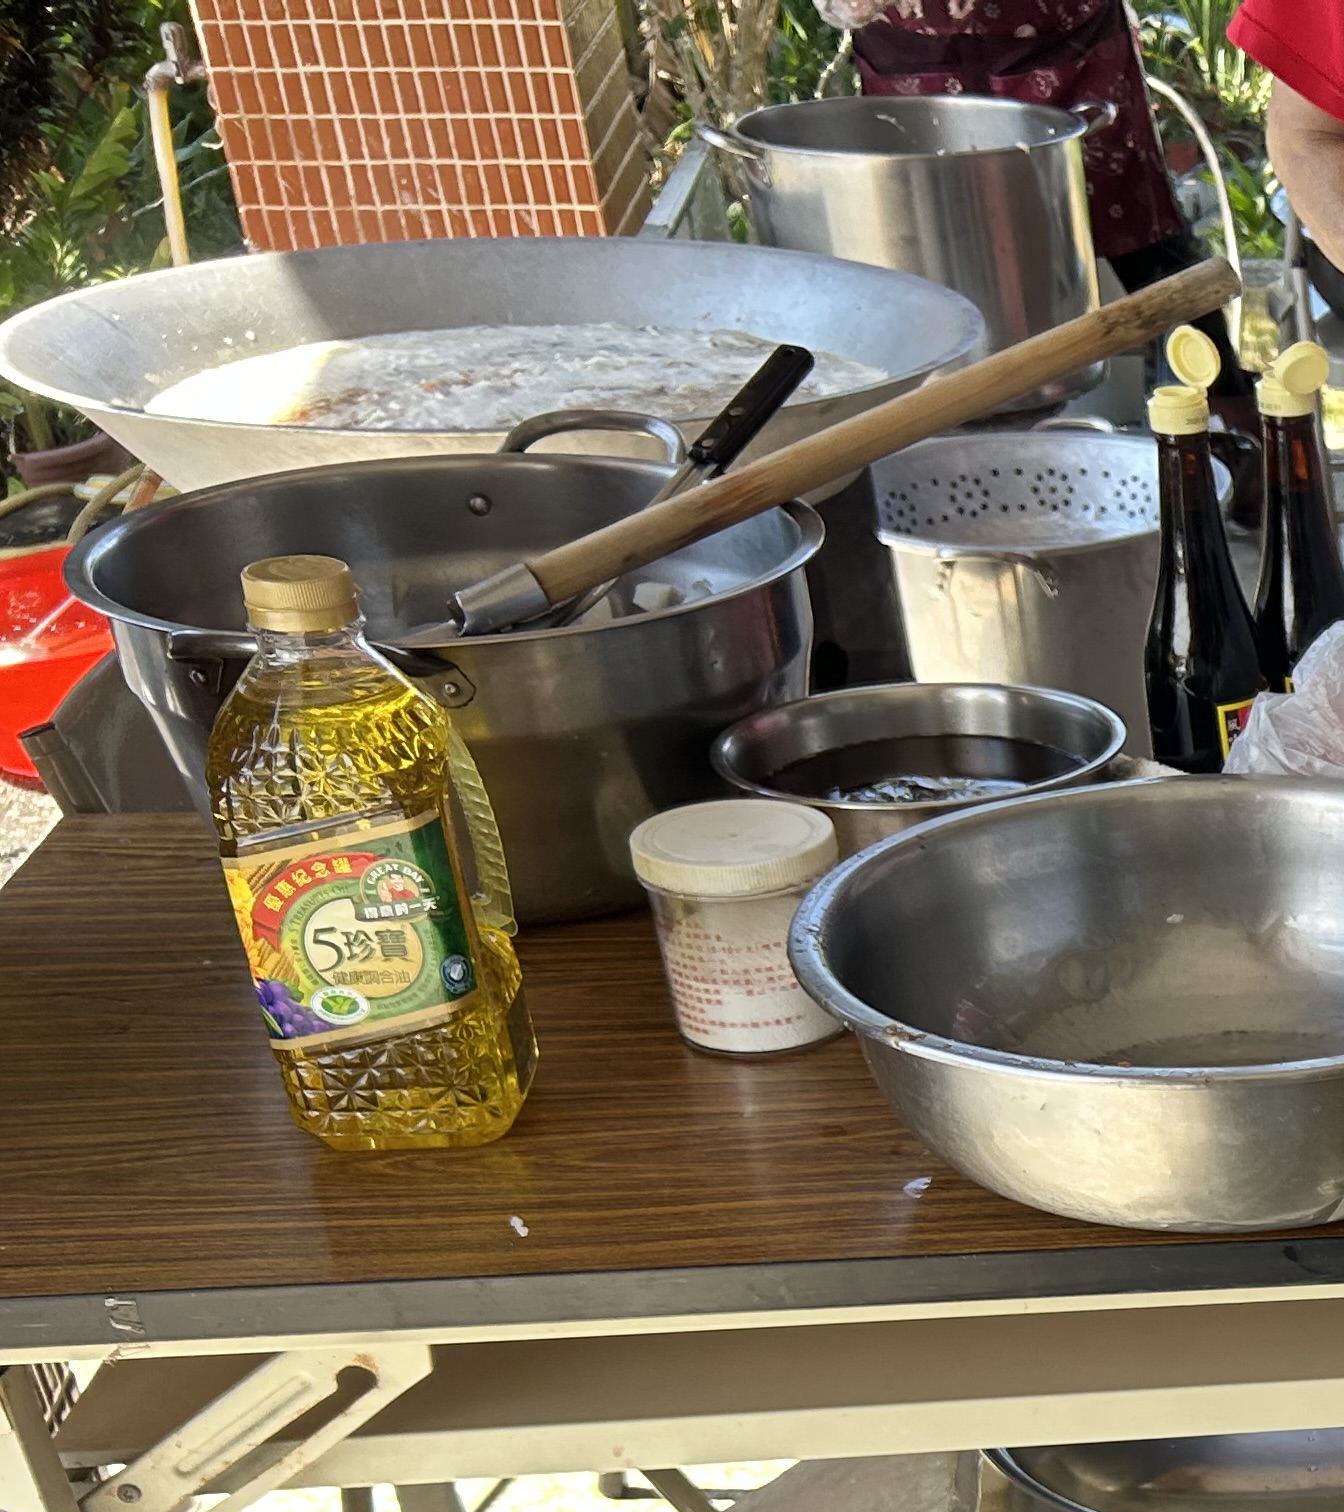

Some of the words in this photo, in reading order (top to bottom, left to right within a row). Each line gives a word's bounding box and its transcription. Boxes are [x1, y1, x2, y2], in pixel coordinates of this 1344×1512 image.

[366, 863, 400, 885] GREAT
[402, 866, 425, 883] DAY
[363, 896, 438, 919] 得意的一天
[312, 926, 415, 972] 5珍寶
